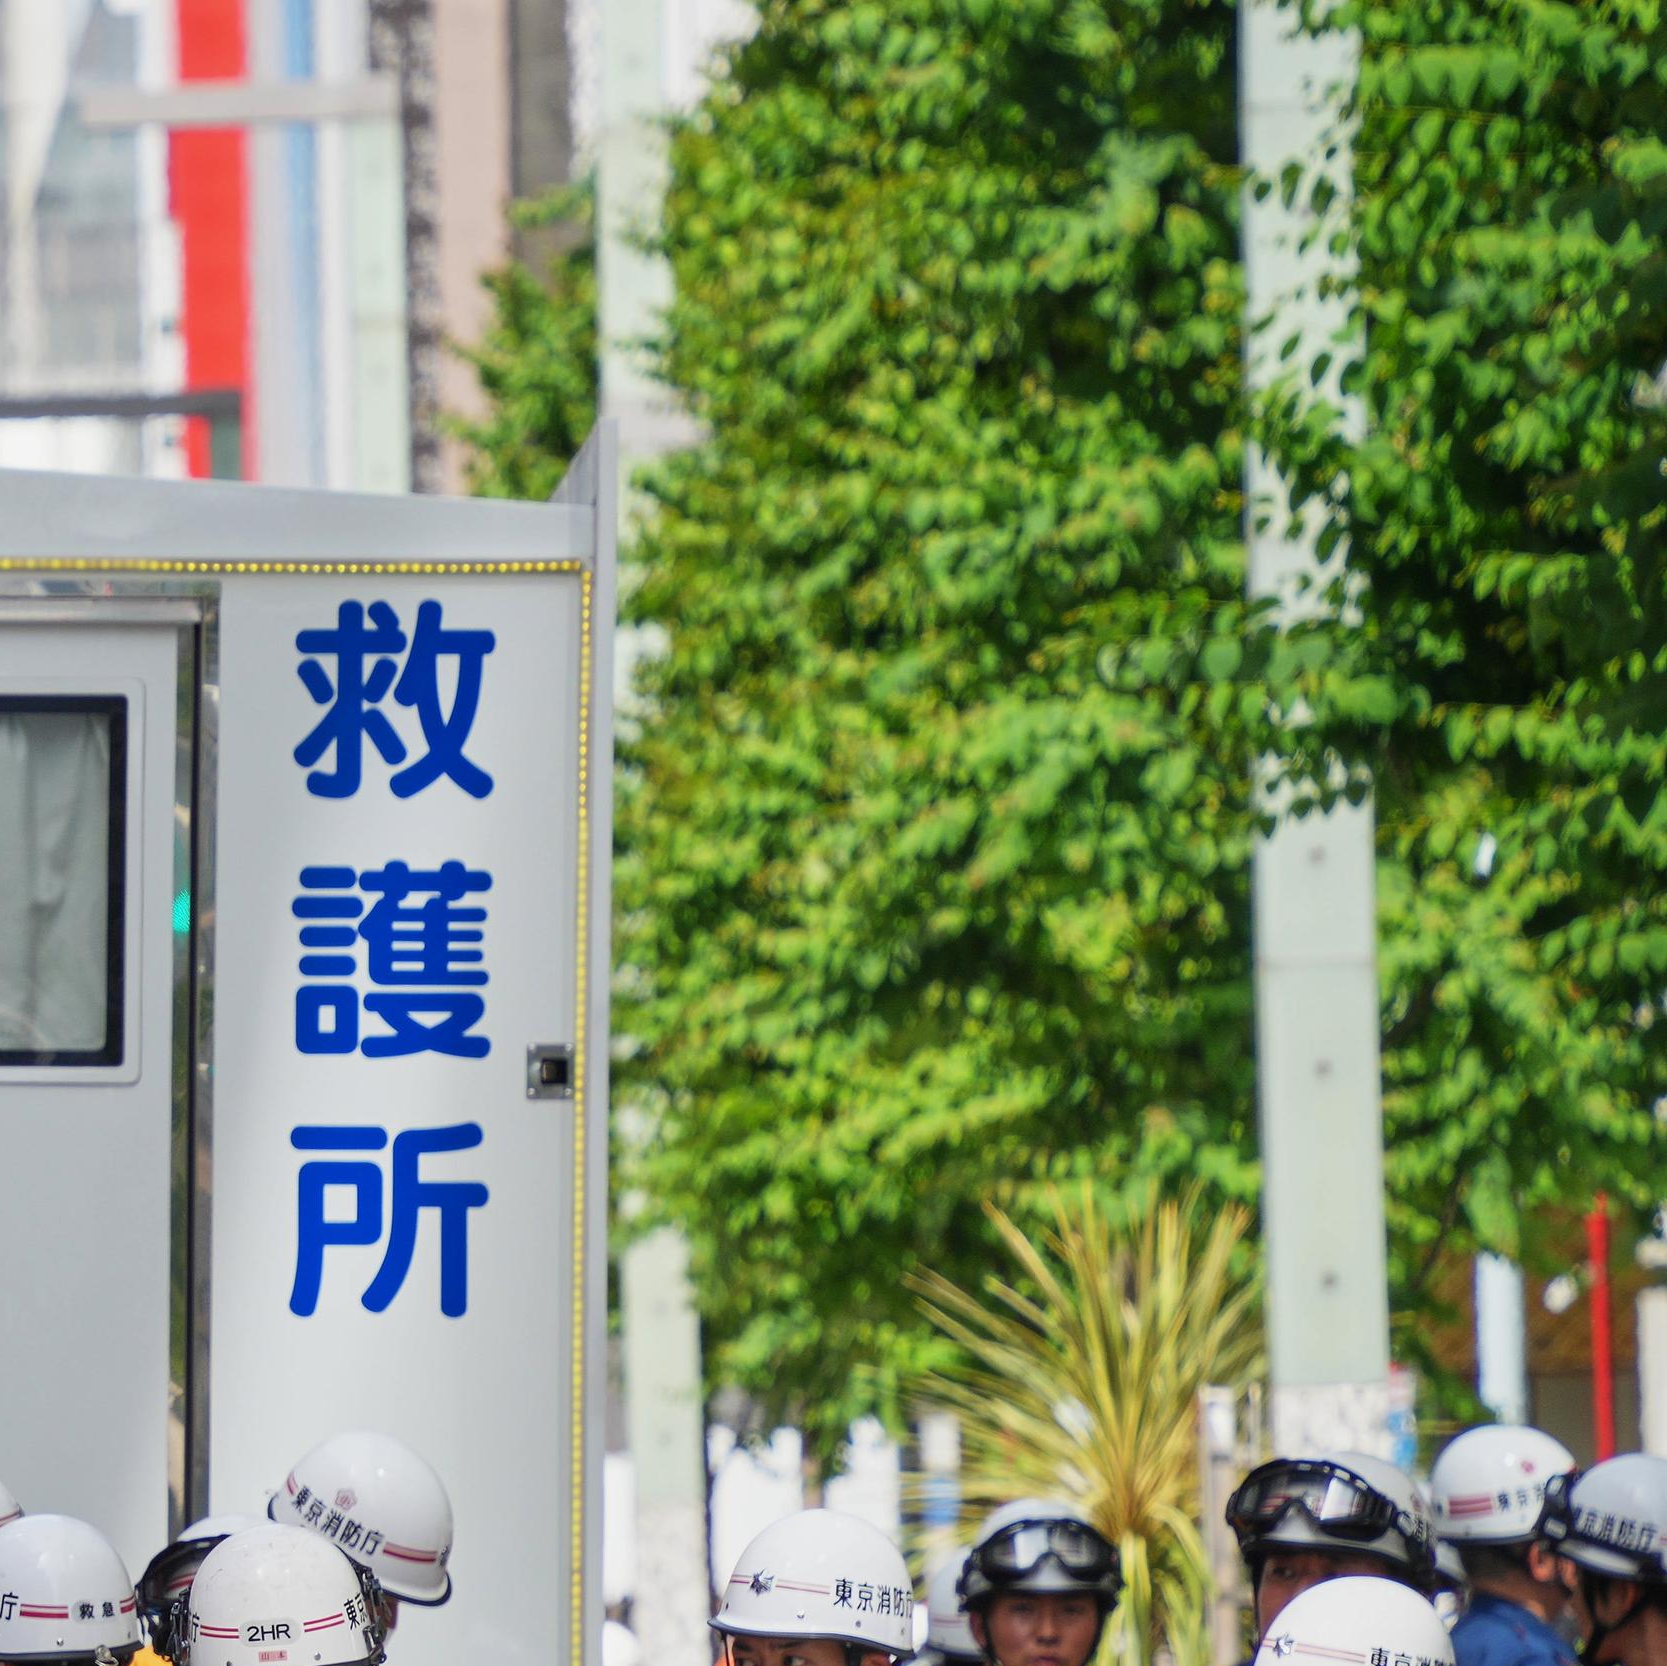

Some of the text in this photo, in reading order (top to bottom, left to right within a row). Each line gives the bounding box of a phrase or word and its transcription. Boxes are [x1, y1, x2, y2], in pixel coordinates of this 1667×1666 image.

[289, 600, 496, 1317] 救護所
[291, 1484, 386, 1556] 東京消防庁
[78, 1601, 115, 1620] 救急
[246, 1623, 291, 1642] 2HR
